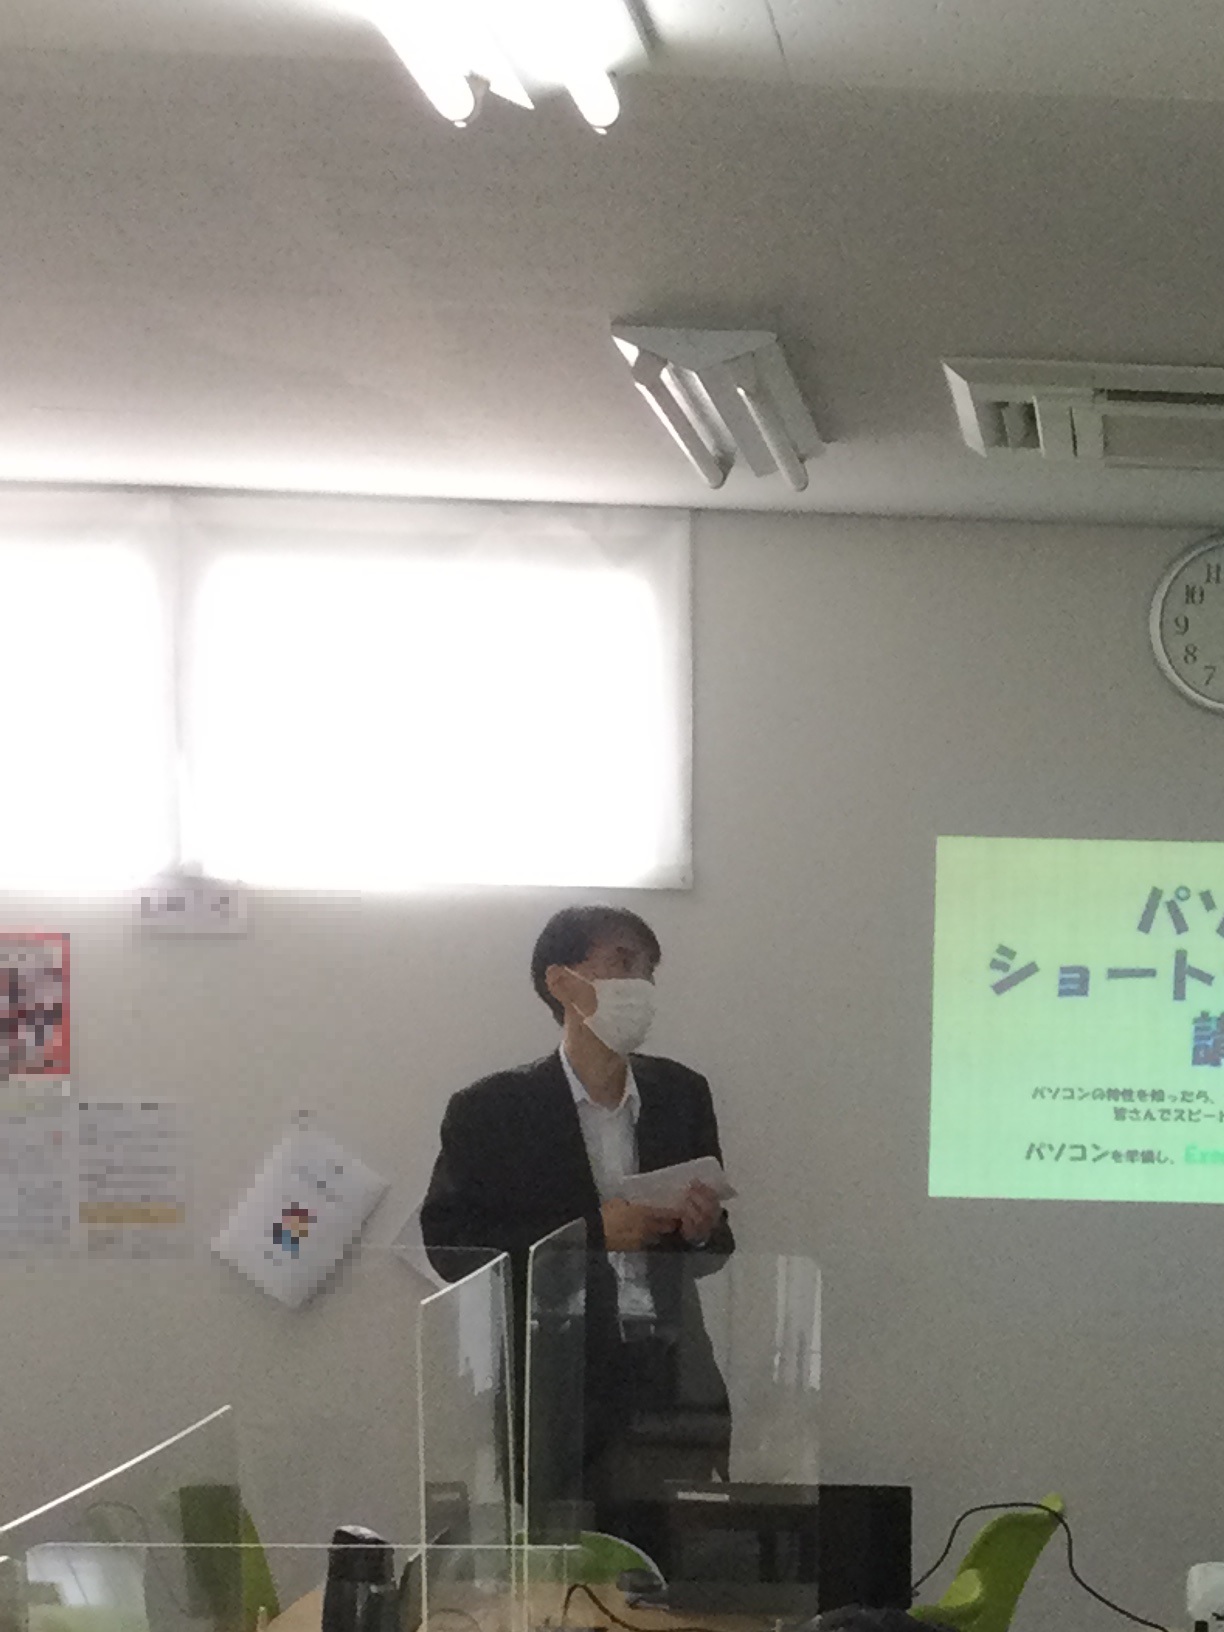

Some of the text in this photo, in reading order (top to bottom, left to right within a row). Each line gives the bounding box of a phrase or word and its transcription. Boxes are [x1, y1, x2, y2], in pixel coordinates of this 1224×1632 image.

[1205, 563, 1222, 584] 11
[1184, 584, 1204, 605] 10
[1174, 614, 1190, 636] 9
[1183, 643, 1198, 665] 8
[1203, 665, 1217, 686] 7
